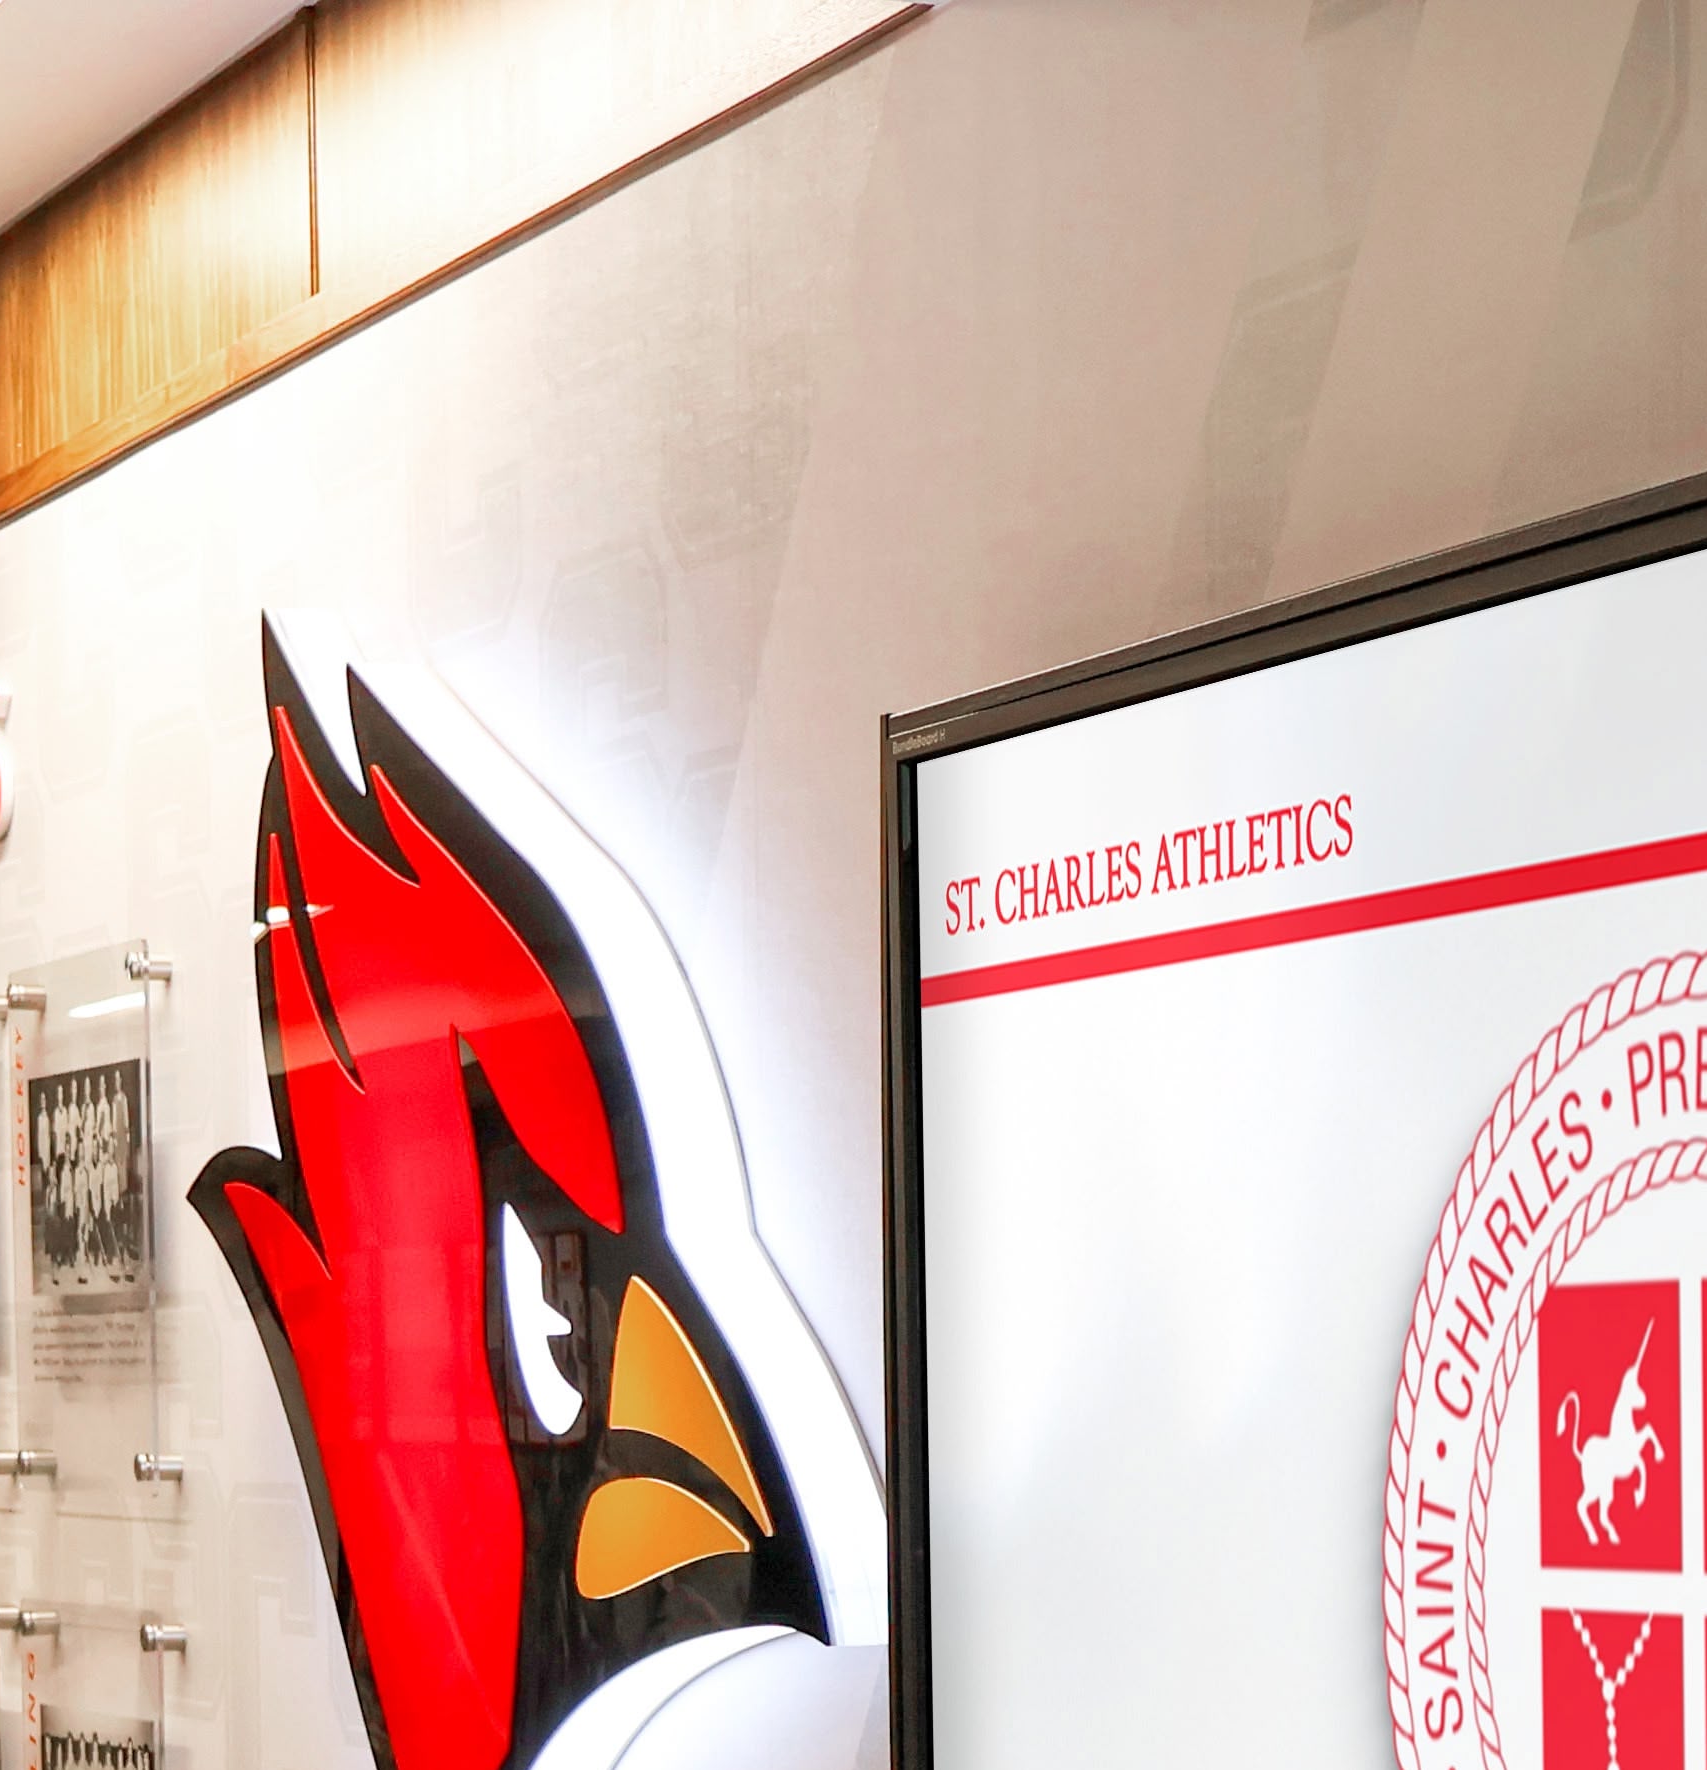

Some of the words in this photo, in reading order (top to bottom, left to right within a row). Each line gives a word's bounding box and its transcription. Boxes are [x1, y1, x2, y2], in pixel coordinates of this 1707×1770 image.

[944, 875, 986, 936] ST.
[994, 840, 1142, 926] CHARLES
[1150, 793, 1354, 895] ATHLETICS
[14, 1028, 27, 1187] HOCKEY
[1433, 1089, 1593, 1420] CHARLES
[1415, 1479, 1464, 1742] SAINT
